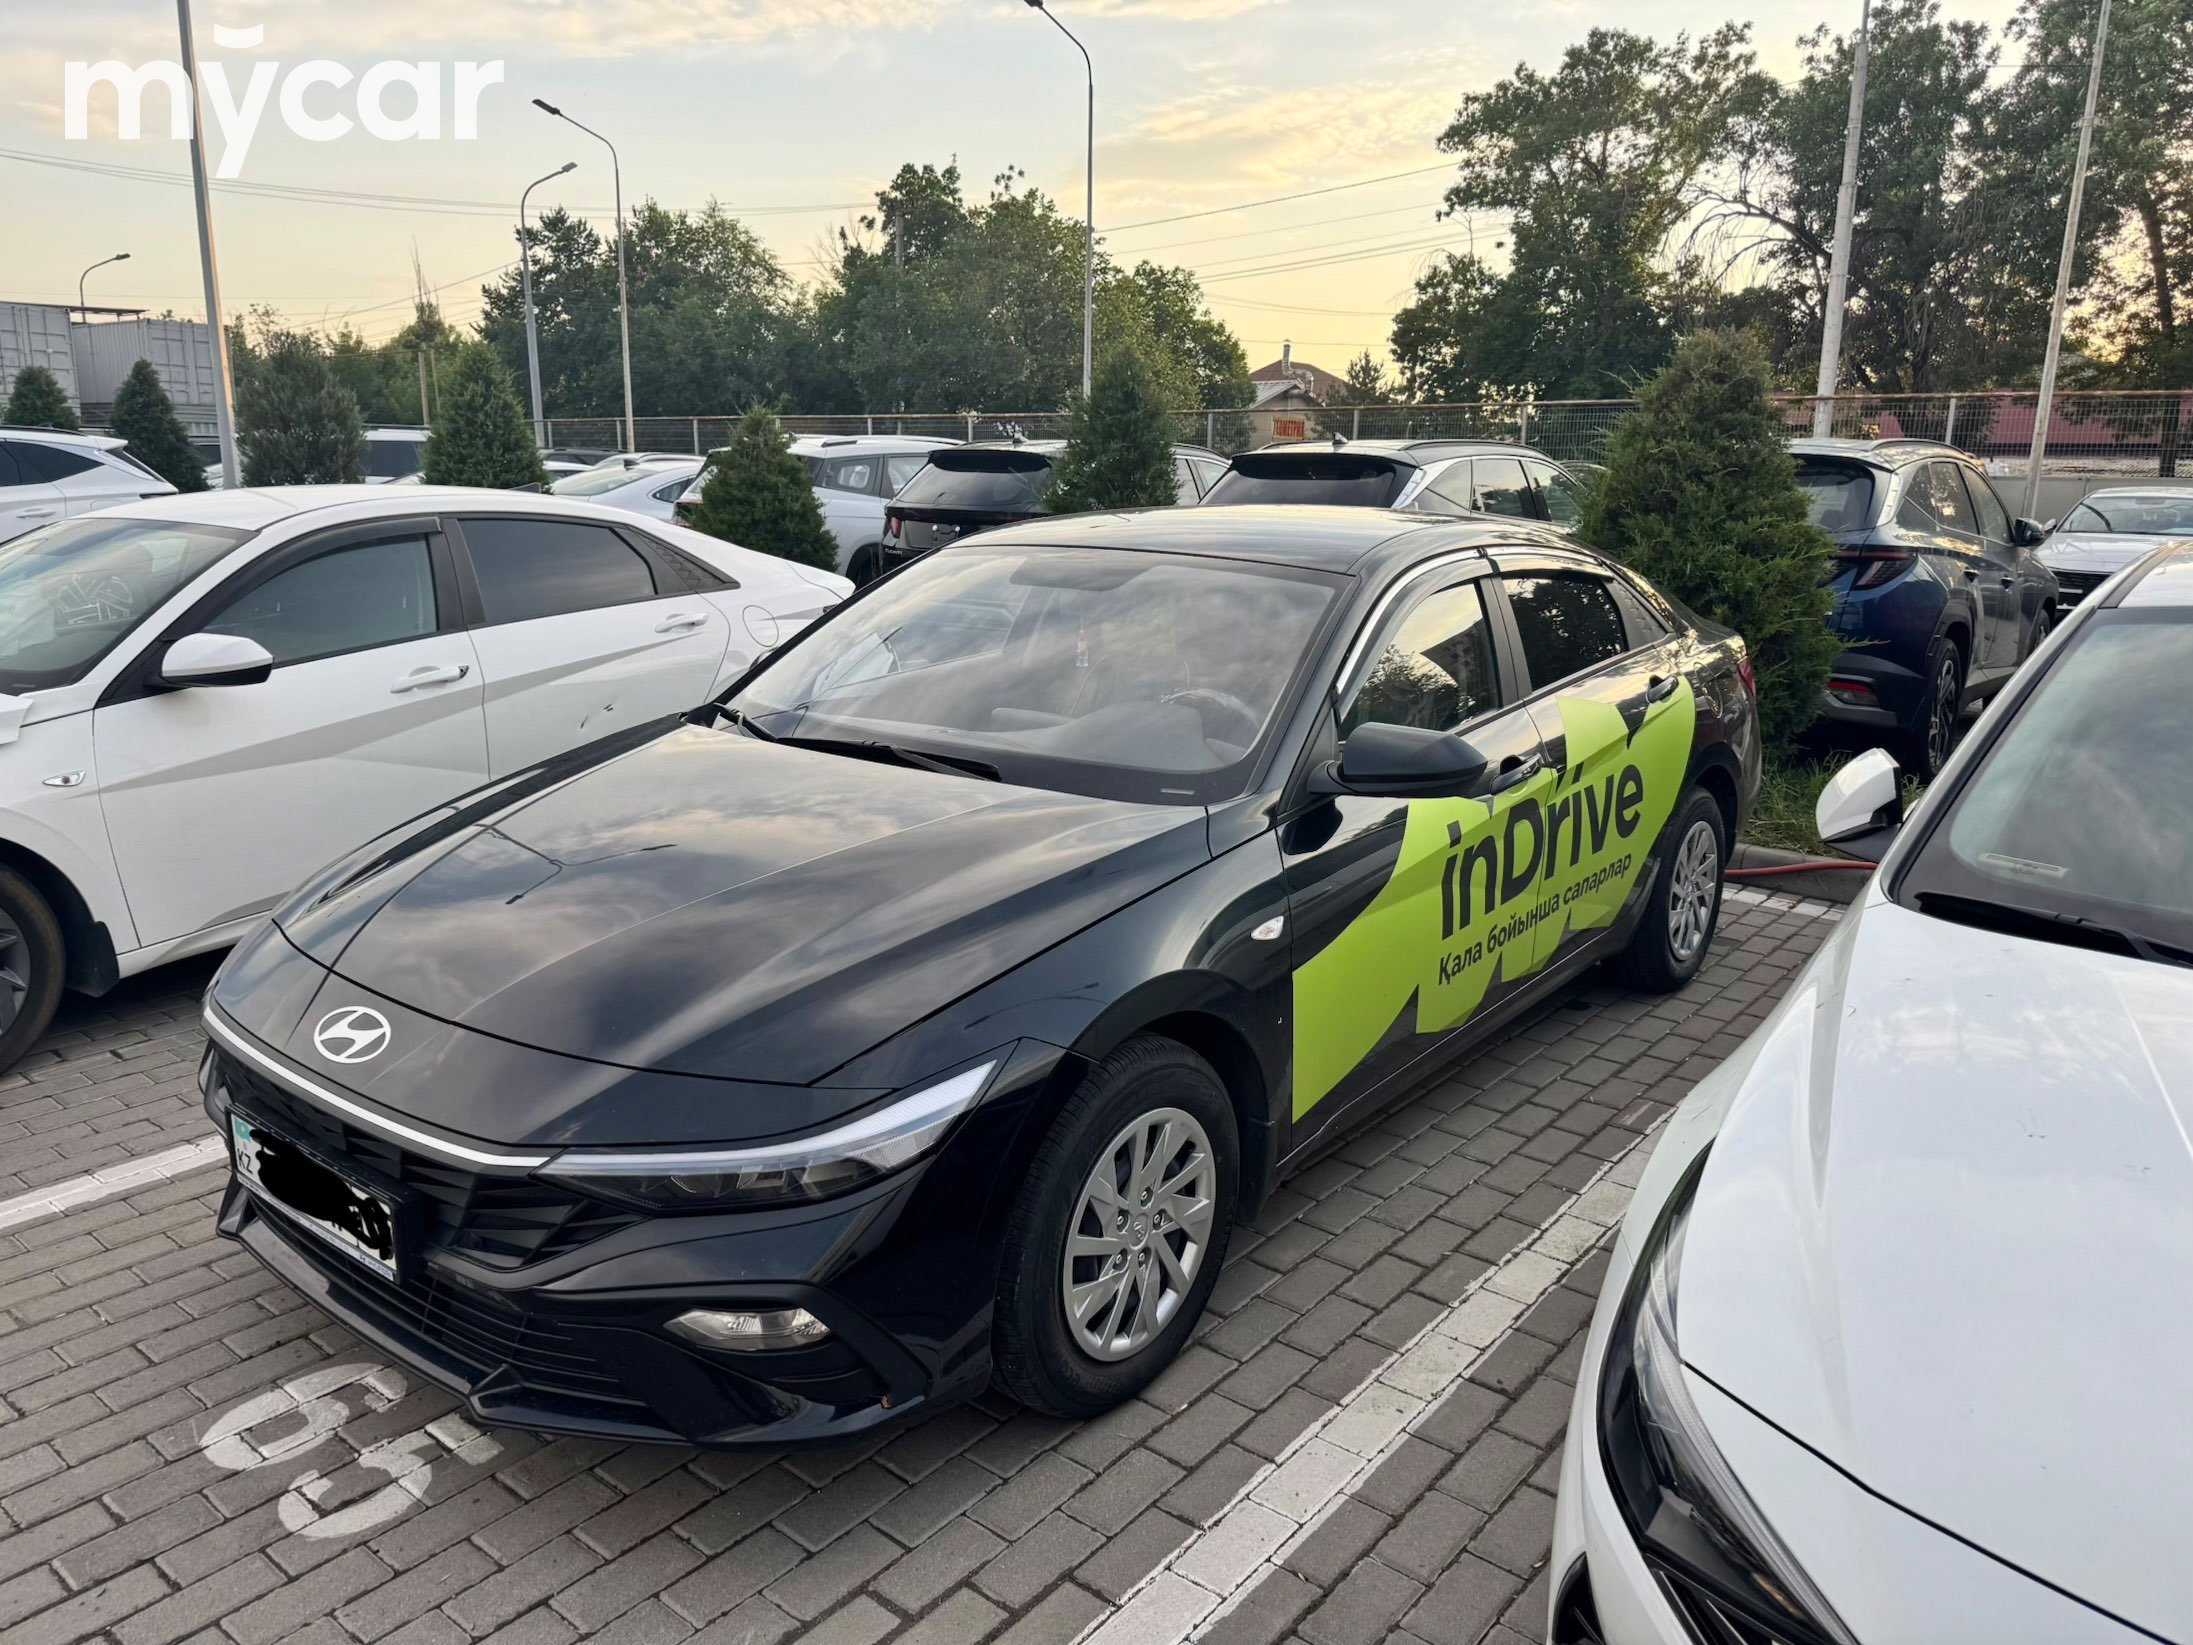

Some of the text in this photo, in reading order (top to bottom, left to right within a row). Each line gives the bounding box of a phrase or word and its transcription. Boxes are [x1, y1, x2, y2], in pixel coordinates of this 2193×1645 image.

[1438, 853, 1632, 986] Қала бойынша сапарлар
[1441, 762, 1643, 941] inDrive
[236, 1147, 254, 1175] KZ
[200, 1363, 504, 1541] 65
